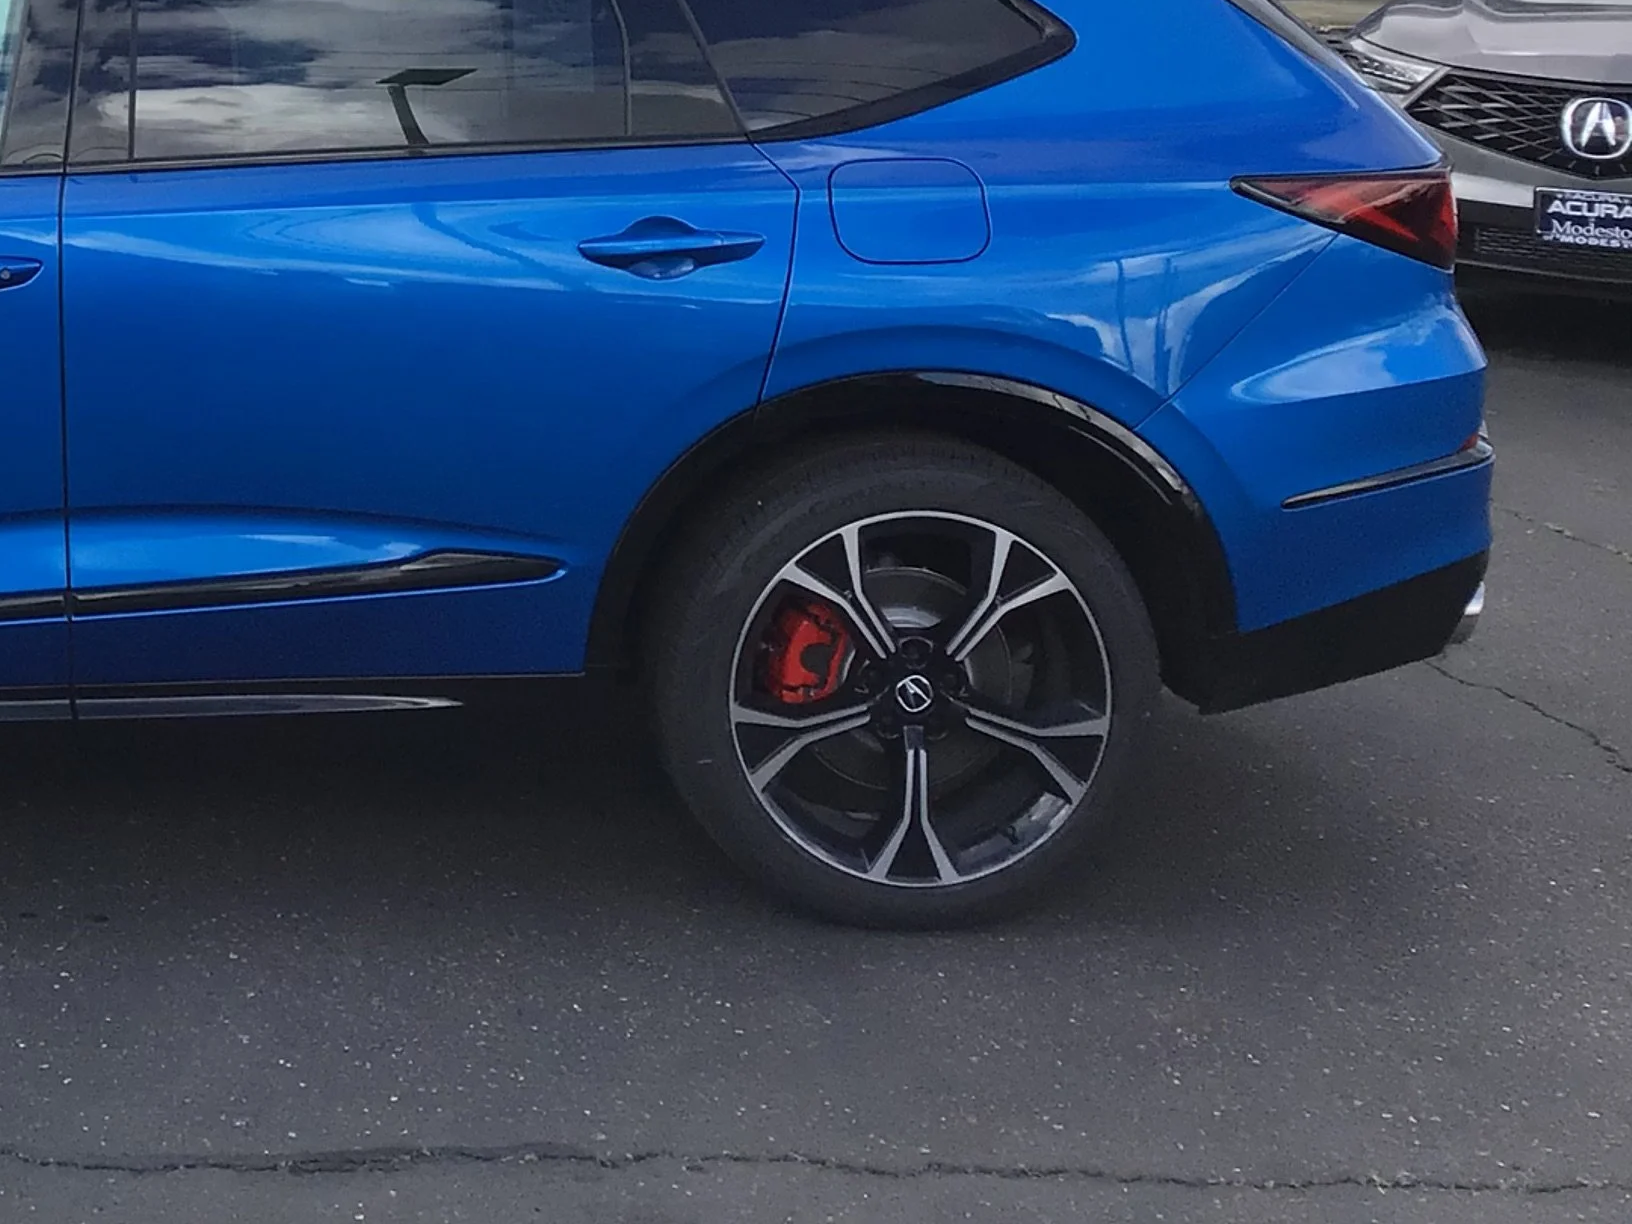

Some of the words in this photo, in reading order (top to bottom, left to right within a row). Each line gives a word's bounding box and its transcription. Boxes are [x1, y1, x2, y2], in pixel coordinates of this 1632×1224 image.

[1547, 200, 1632, 219] ACURA
[1552, 219, 1632, 239] Modesto
[1559, 235, 1632, 249] MODEST
